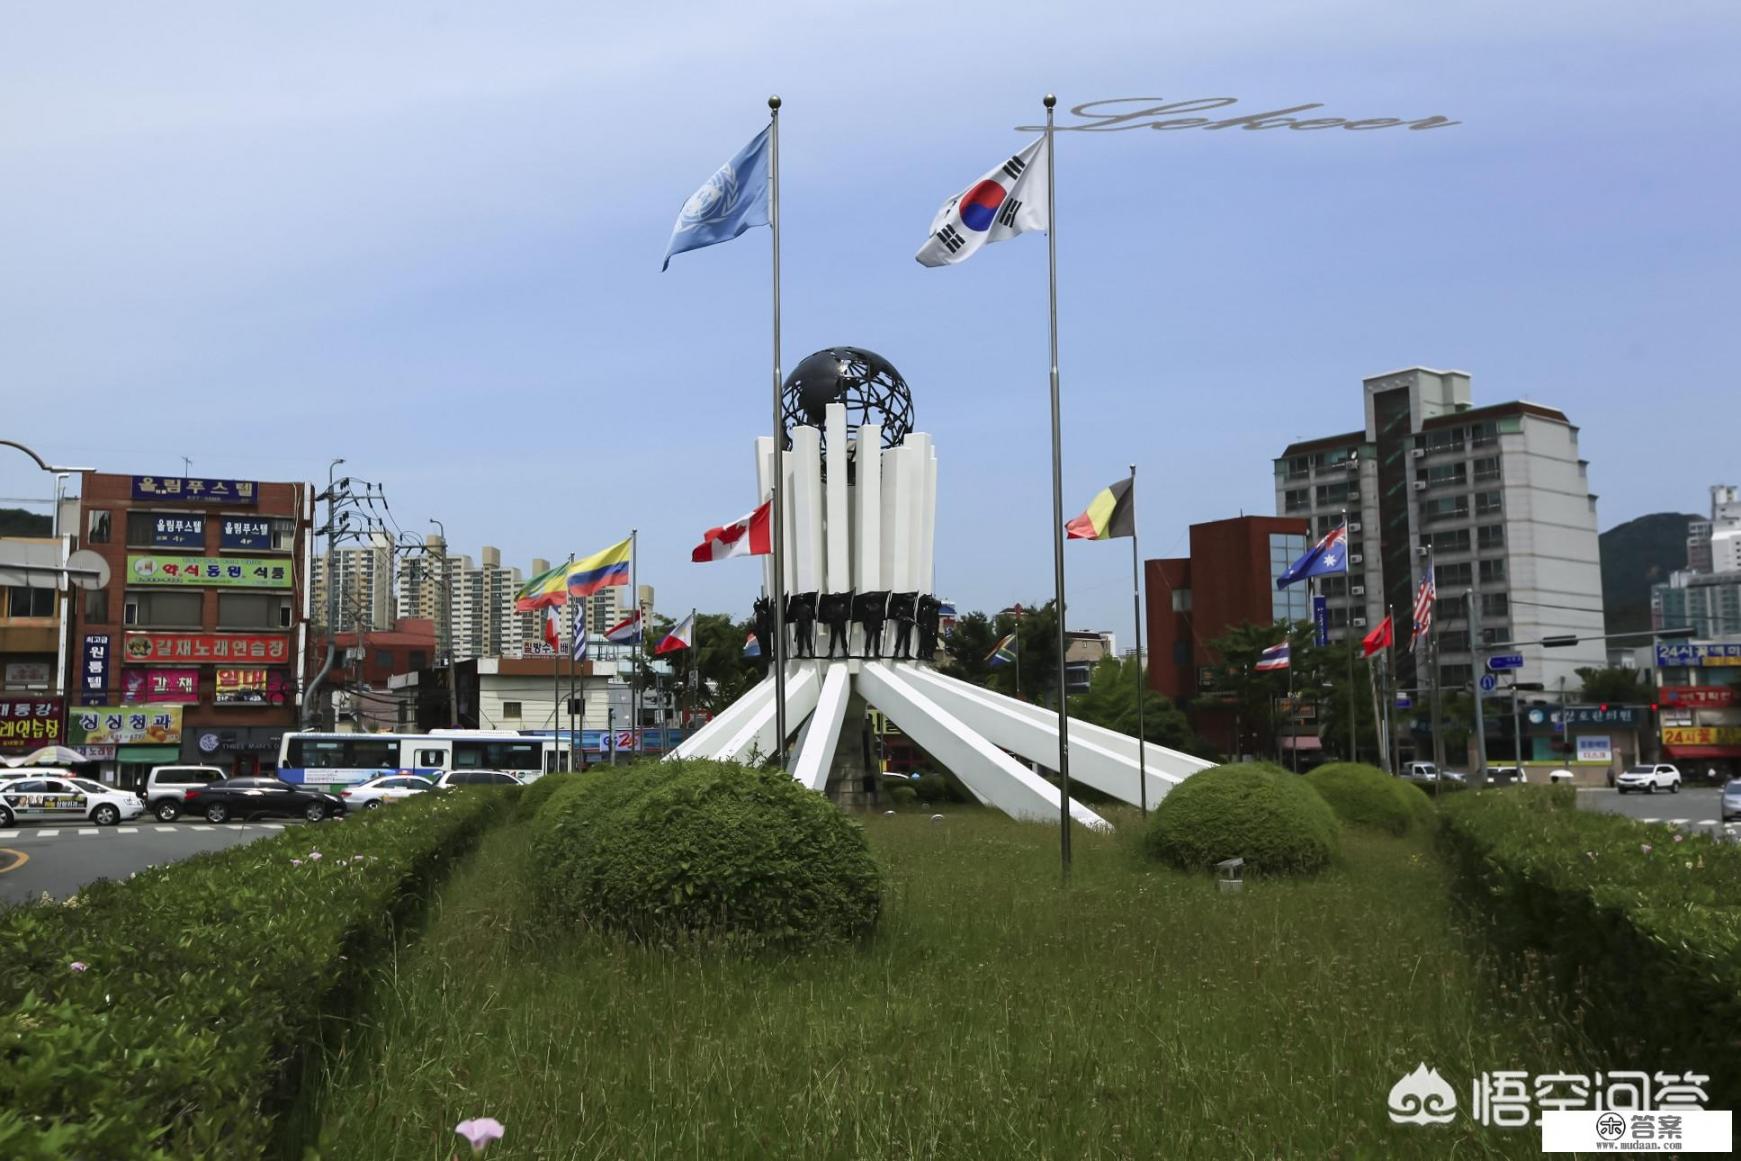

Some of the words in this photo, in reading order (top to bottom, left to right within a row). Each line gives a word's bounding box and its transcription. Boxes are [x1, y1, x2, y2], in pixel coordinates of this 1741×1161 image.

[156, 518, 202, 533] 올림푸스텔
[224, 521, 268, 535] 올림푸스텔
[79, 712, 172, 731] 싱싱청과
